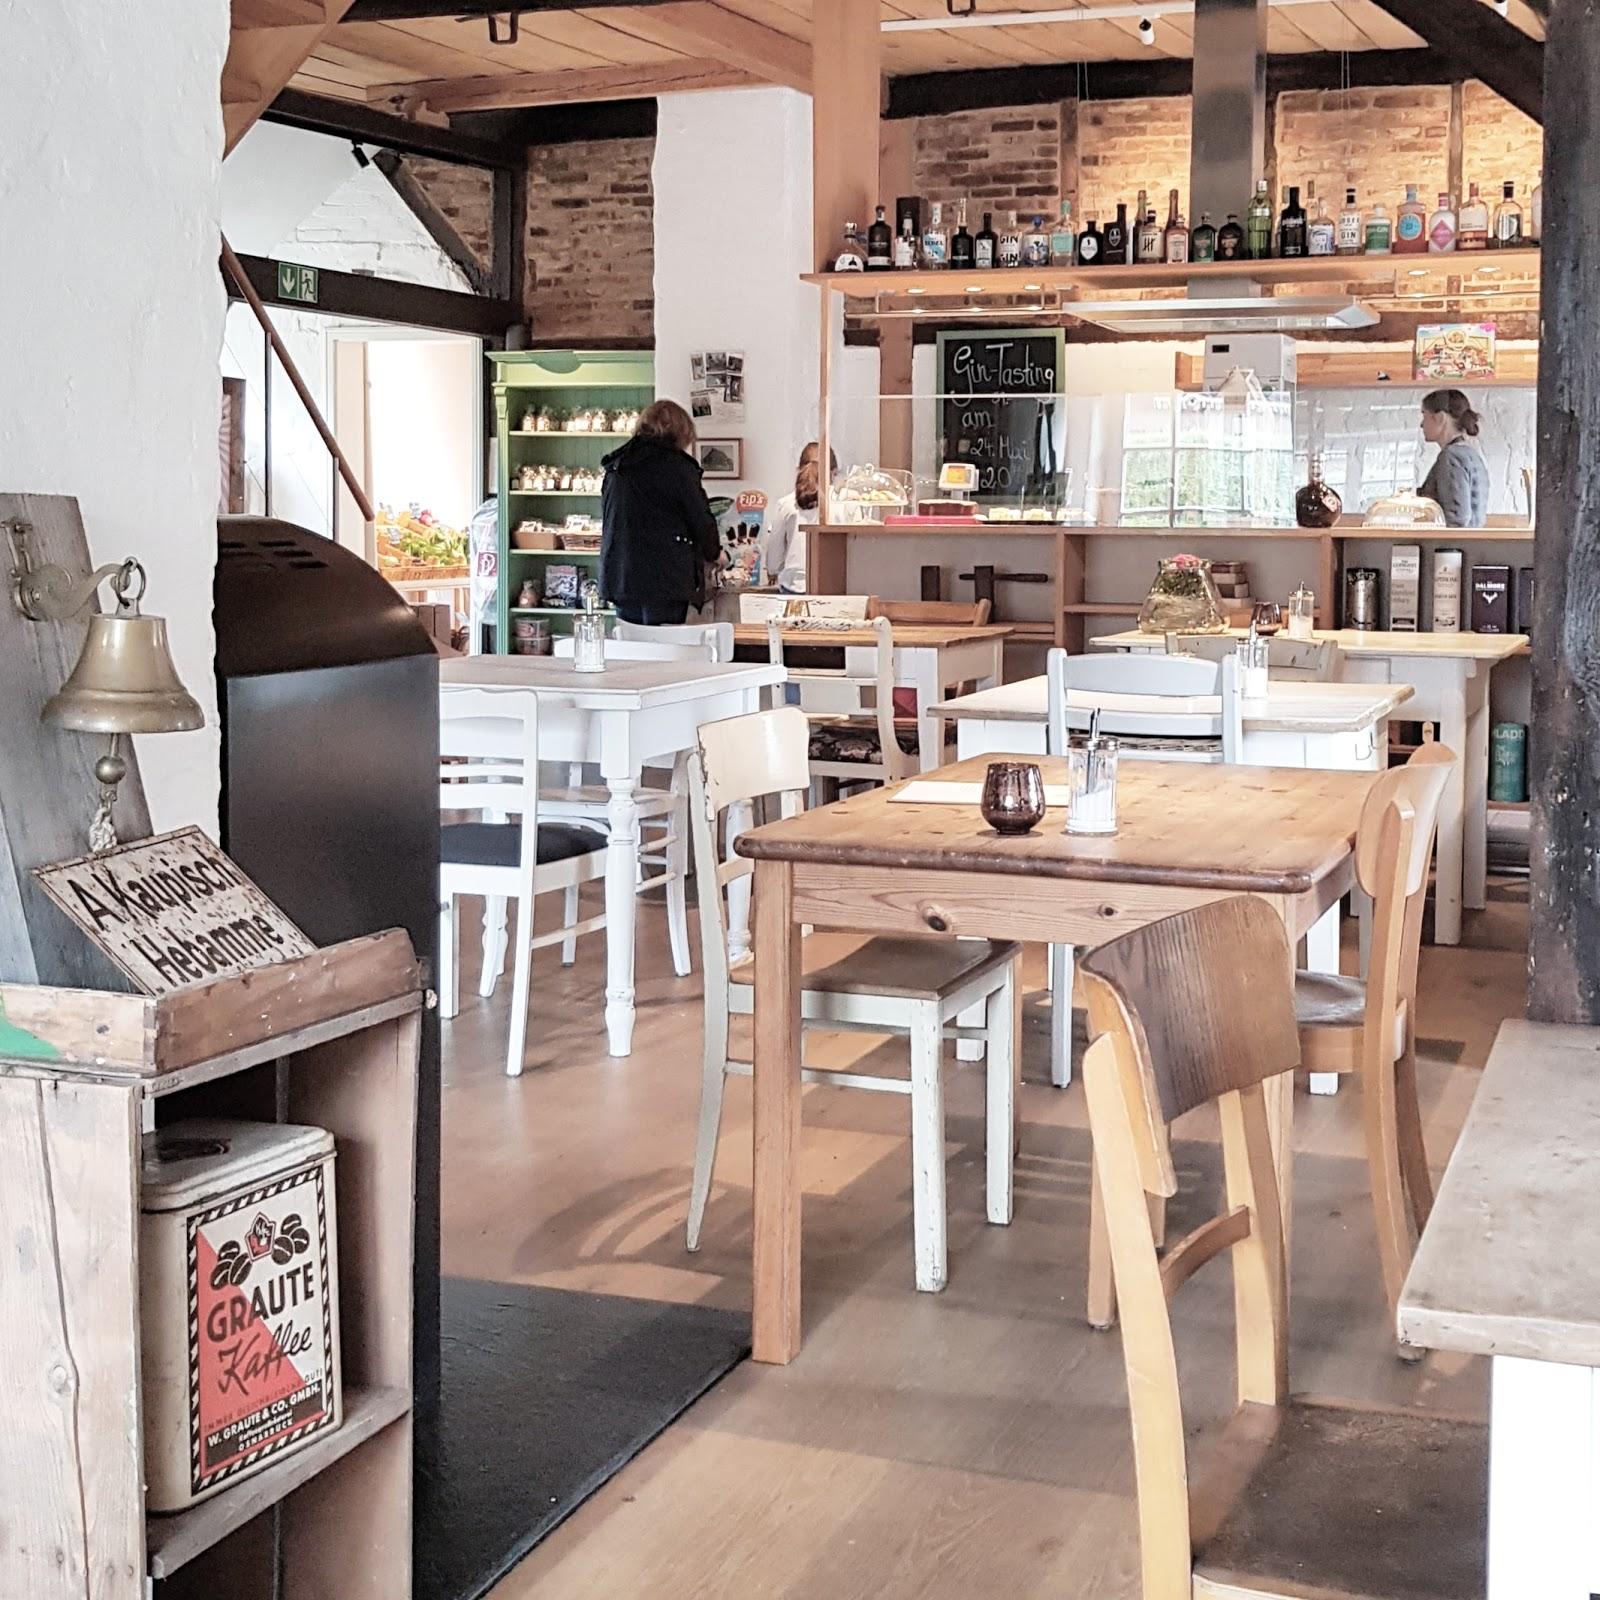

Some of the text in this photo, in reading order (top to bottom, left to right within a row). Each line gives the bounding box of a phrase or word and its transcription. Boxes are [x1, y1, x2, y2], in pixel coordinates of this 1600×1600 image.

[999, 235, 1019, 245] GIN
[961, 409, 997, 428] am
[130, 913, 286, 987] Hebamme
[206, 1260, 315, 1342] GRAUTE
[217, 1319, 313, 1395] Kaffee
[223, 1410, 261, 1440] GRAUTE
